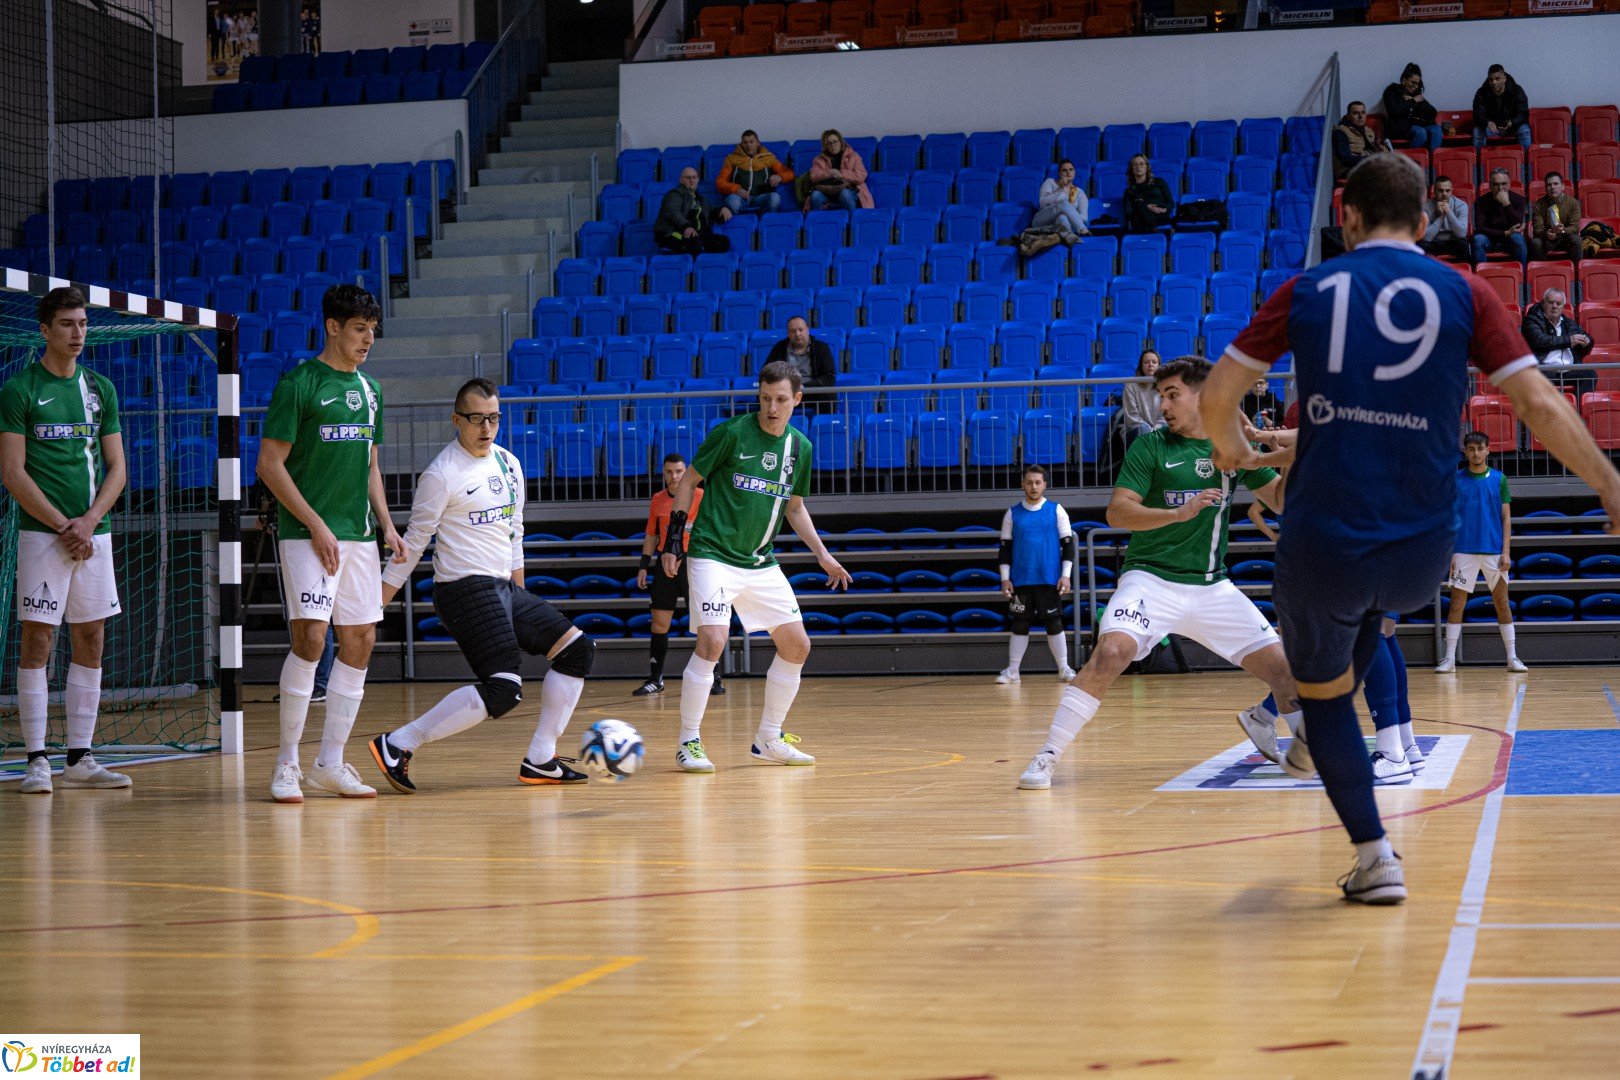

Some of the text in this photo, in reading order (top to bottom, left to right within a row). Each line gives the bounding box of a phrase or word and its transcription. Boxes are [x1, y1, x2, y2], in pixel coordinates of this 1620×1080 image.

[1541, 0, 1591, 8] MICHELIN
[1412, 5, 1462, 14] MICHELIN
[1283, 11, 1332, 20] MICHELIN
[1157, 18, 1205, 26] MICHELIN
[1032, 24, 1080, 33] MICHELIN
[909, 31, 955, 39] MICHELIN
[787, 35, 833, 45] MICHELIN
[667, 43, 714, 52] MICHELIN
[1316, 271, 1441, 381] 19
[1337, 406, 1428, 431] NYÍREGYHÁZA
